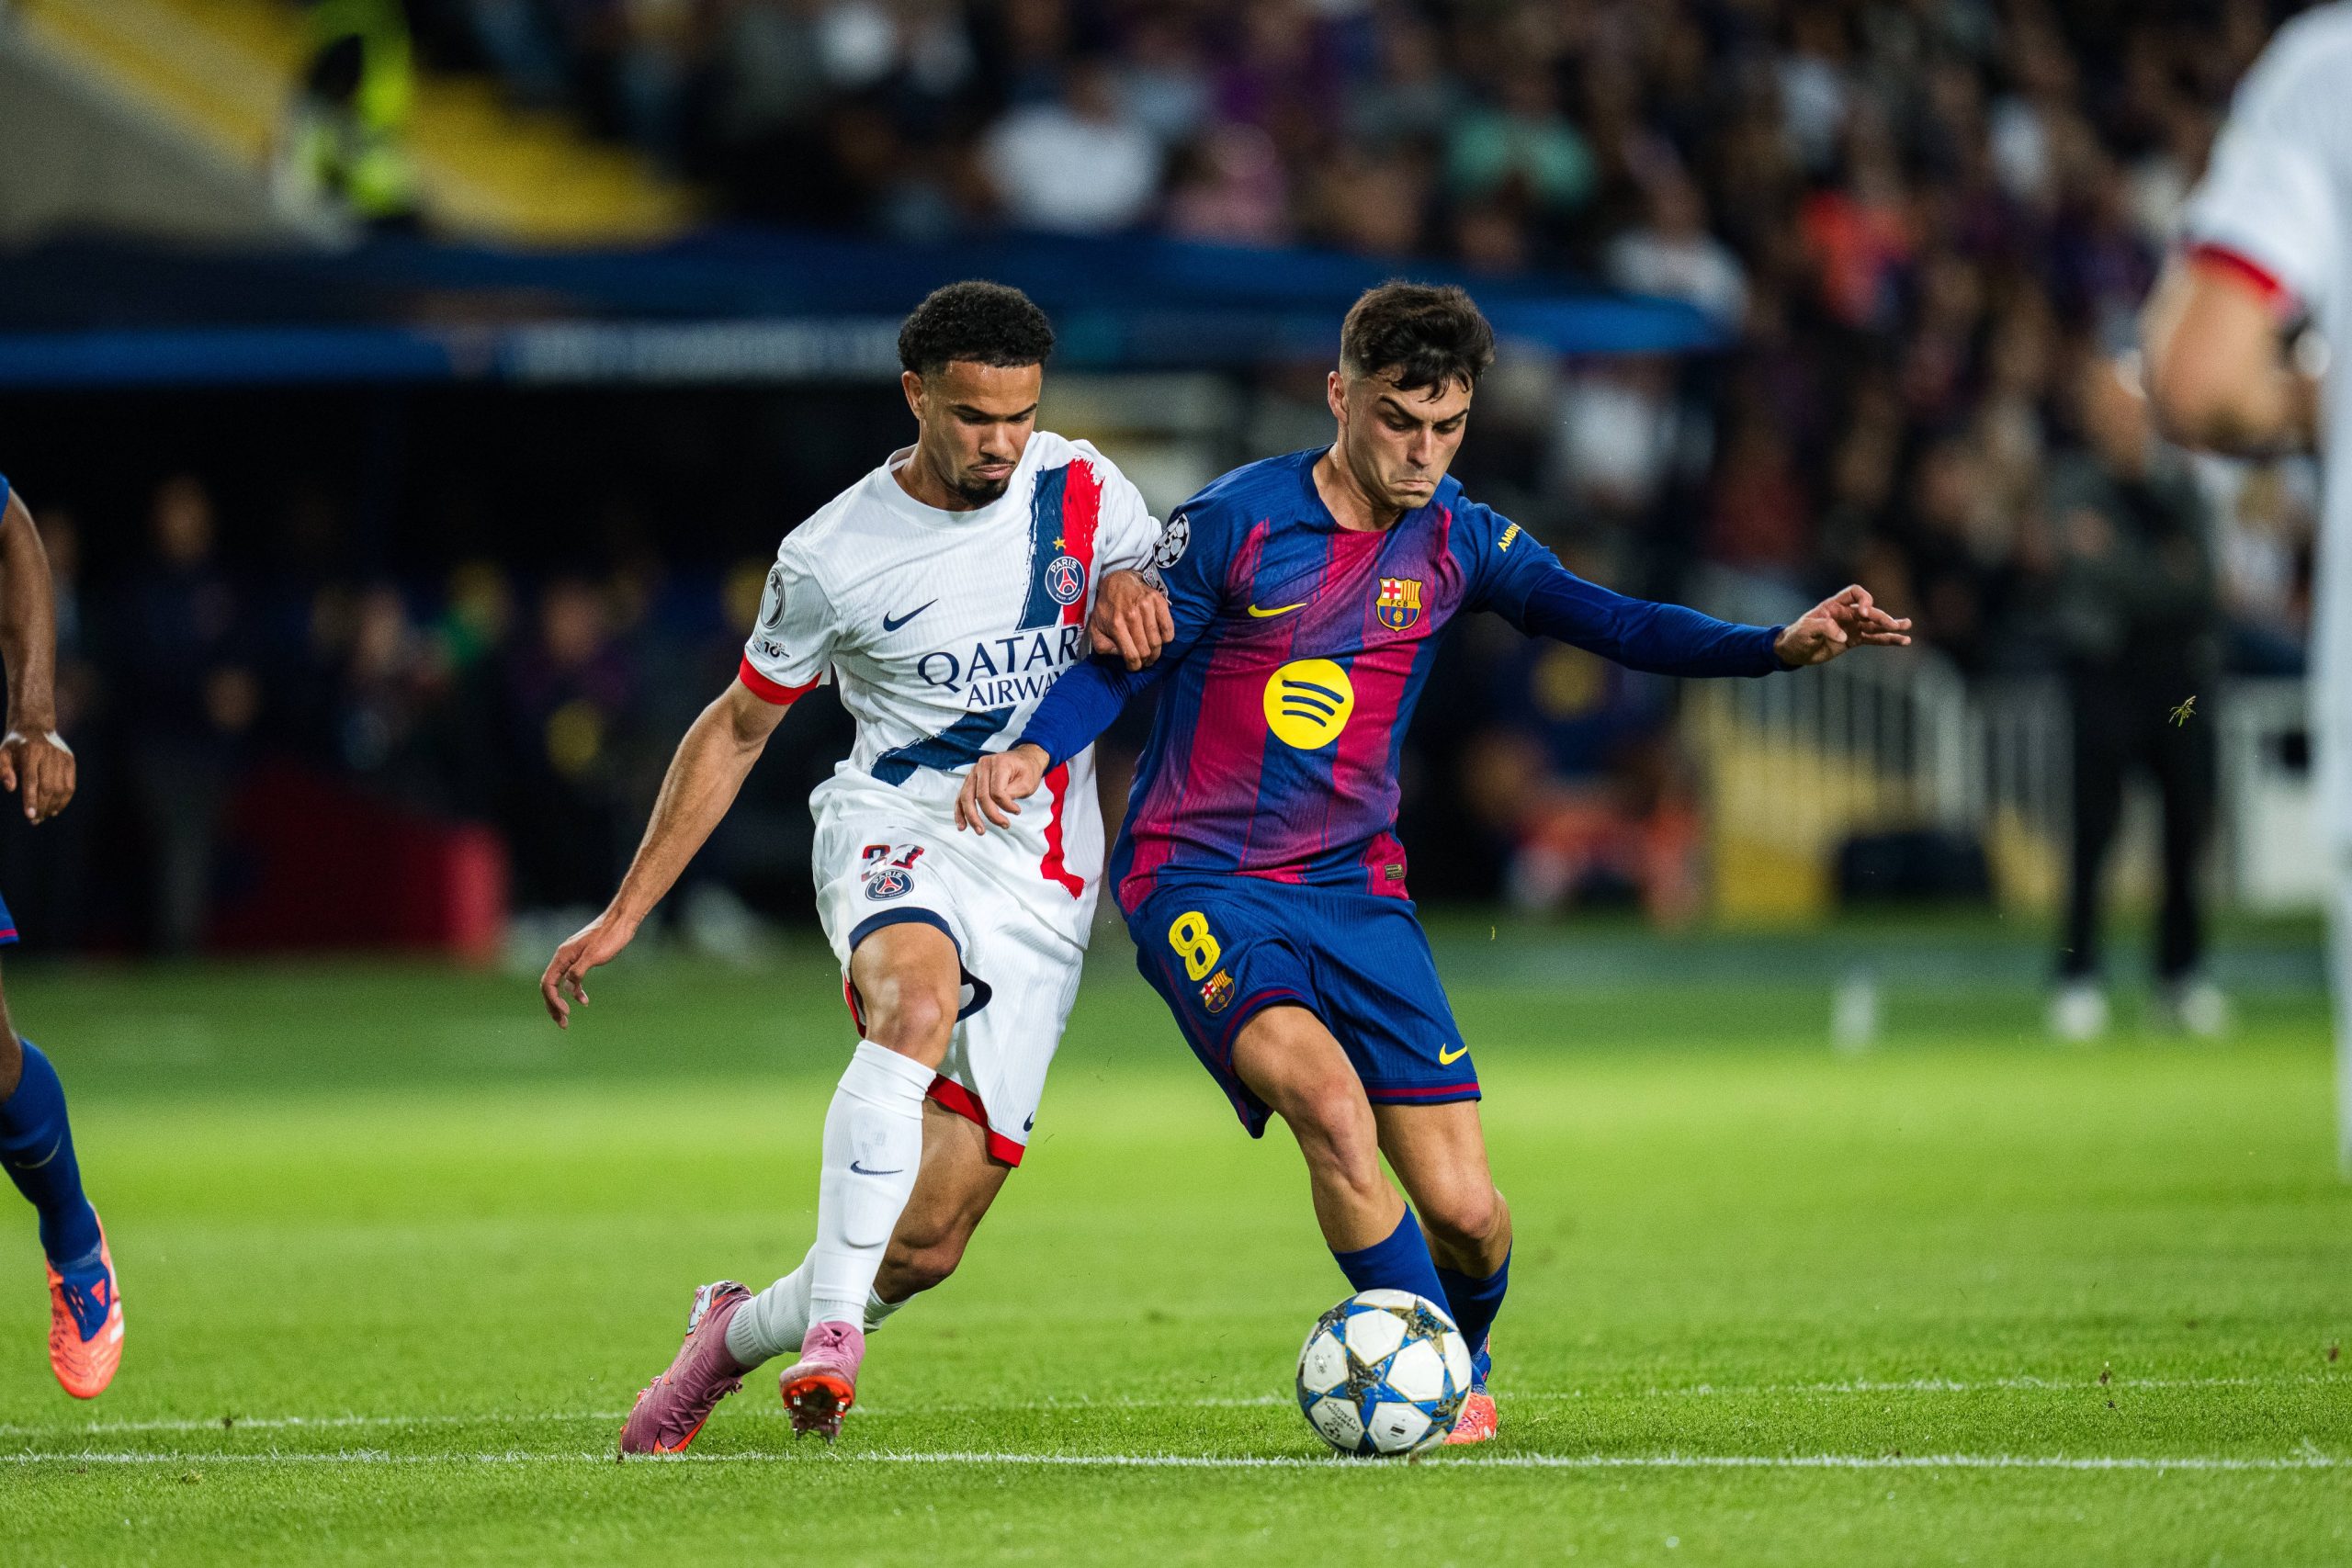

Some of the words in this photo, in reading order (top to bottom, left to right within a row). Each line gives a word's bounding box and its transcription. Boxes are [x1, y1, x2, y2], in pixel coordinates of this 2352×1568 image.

[1050, 558, 1077, 573] PARIS
[763, 641, 781, 658] 10
[917, 626, 1079, 694] QATAR
[966, 666, 1073, 708] AIRWA
[1169, 910, 1221, 981] 8
